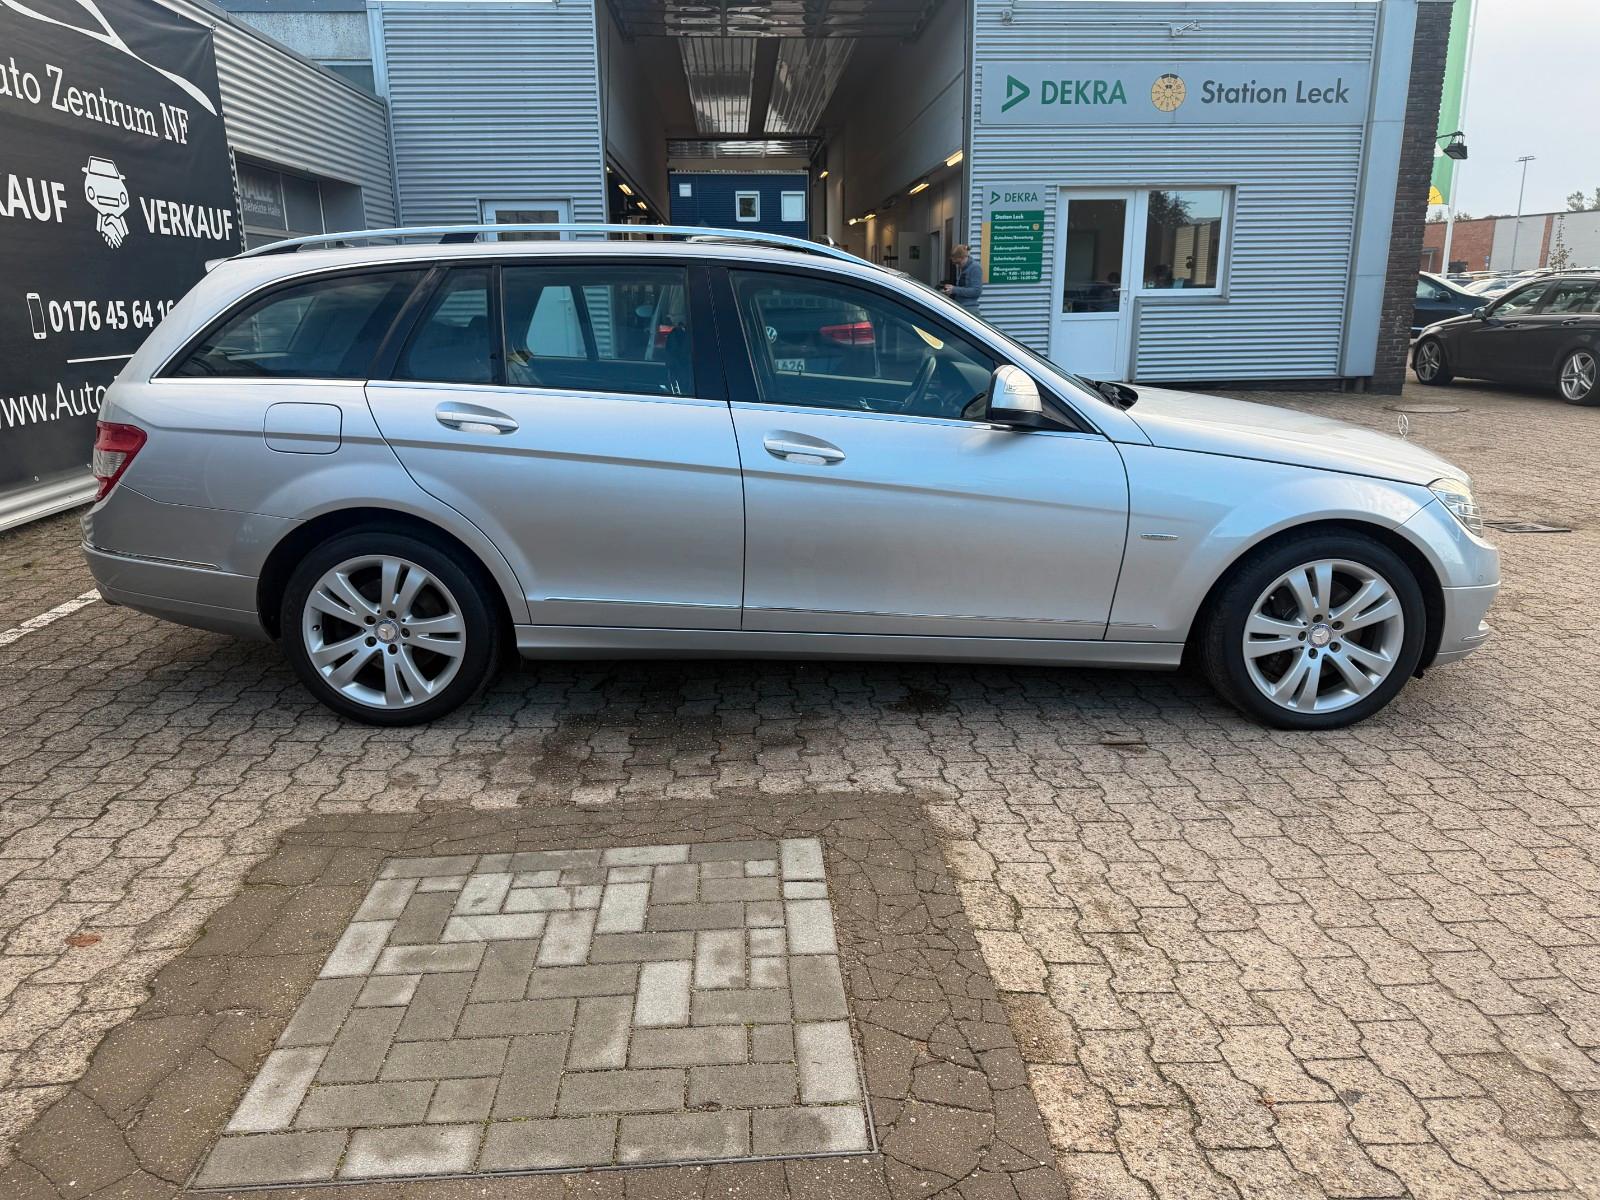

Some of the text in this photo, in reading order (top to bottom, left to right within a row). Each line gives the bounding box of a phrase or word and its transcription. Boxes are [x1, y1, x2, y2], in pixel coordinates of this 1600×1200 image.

[46, 64, 158, 137] Zentrum
[160, 102, 188, 144] NF
[1041, 79, 1127, 105] DEKRA
[1201, 79, 1286, 104] Station
[1296, 77, 1350, 104] Leck
[1004, 192, 1038, 202] DEKRA
[139, 196, 233, 240] VERKAUF
[48, 300, 101, 332] 0176
[106, 300, 128, 329] 45
[132, 300, 154, 328] 64
